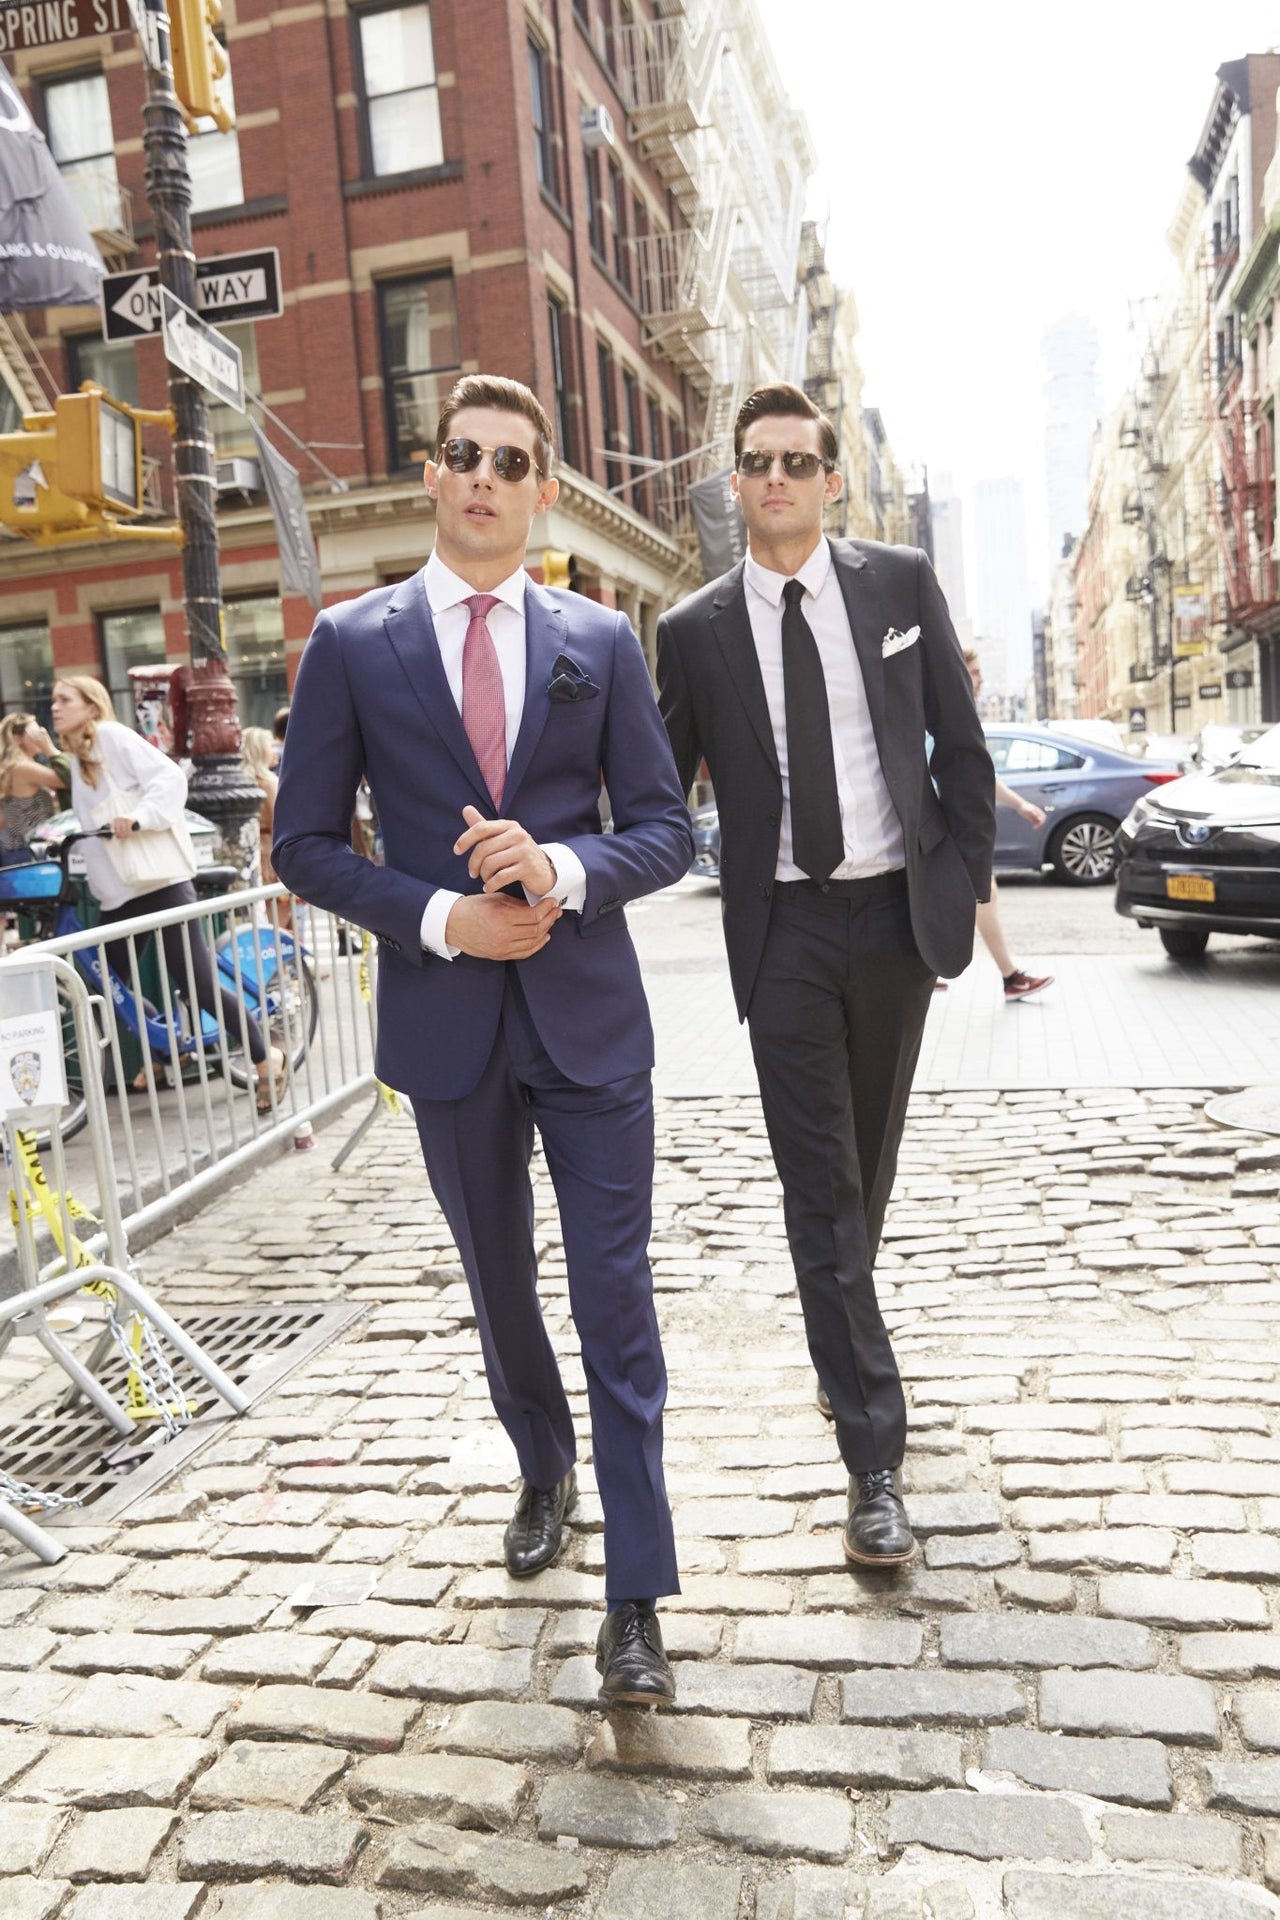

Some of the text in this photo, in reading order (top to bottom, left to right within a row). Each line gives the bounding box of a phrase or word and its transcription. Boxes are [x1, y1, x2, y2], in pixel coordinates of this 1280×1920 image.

[130, 275, 253, 316] ON WAY
[13, 1026, 45, 1038] PARKING
